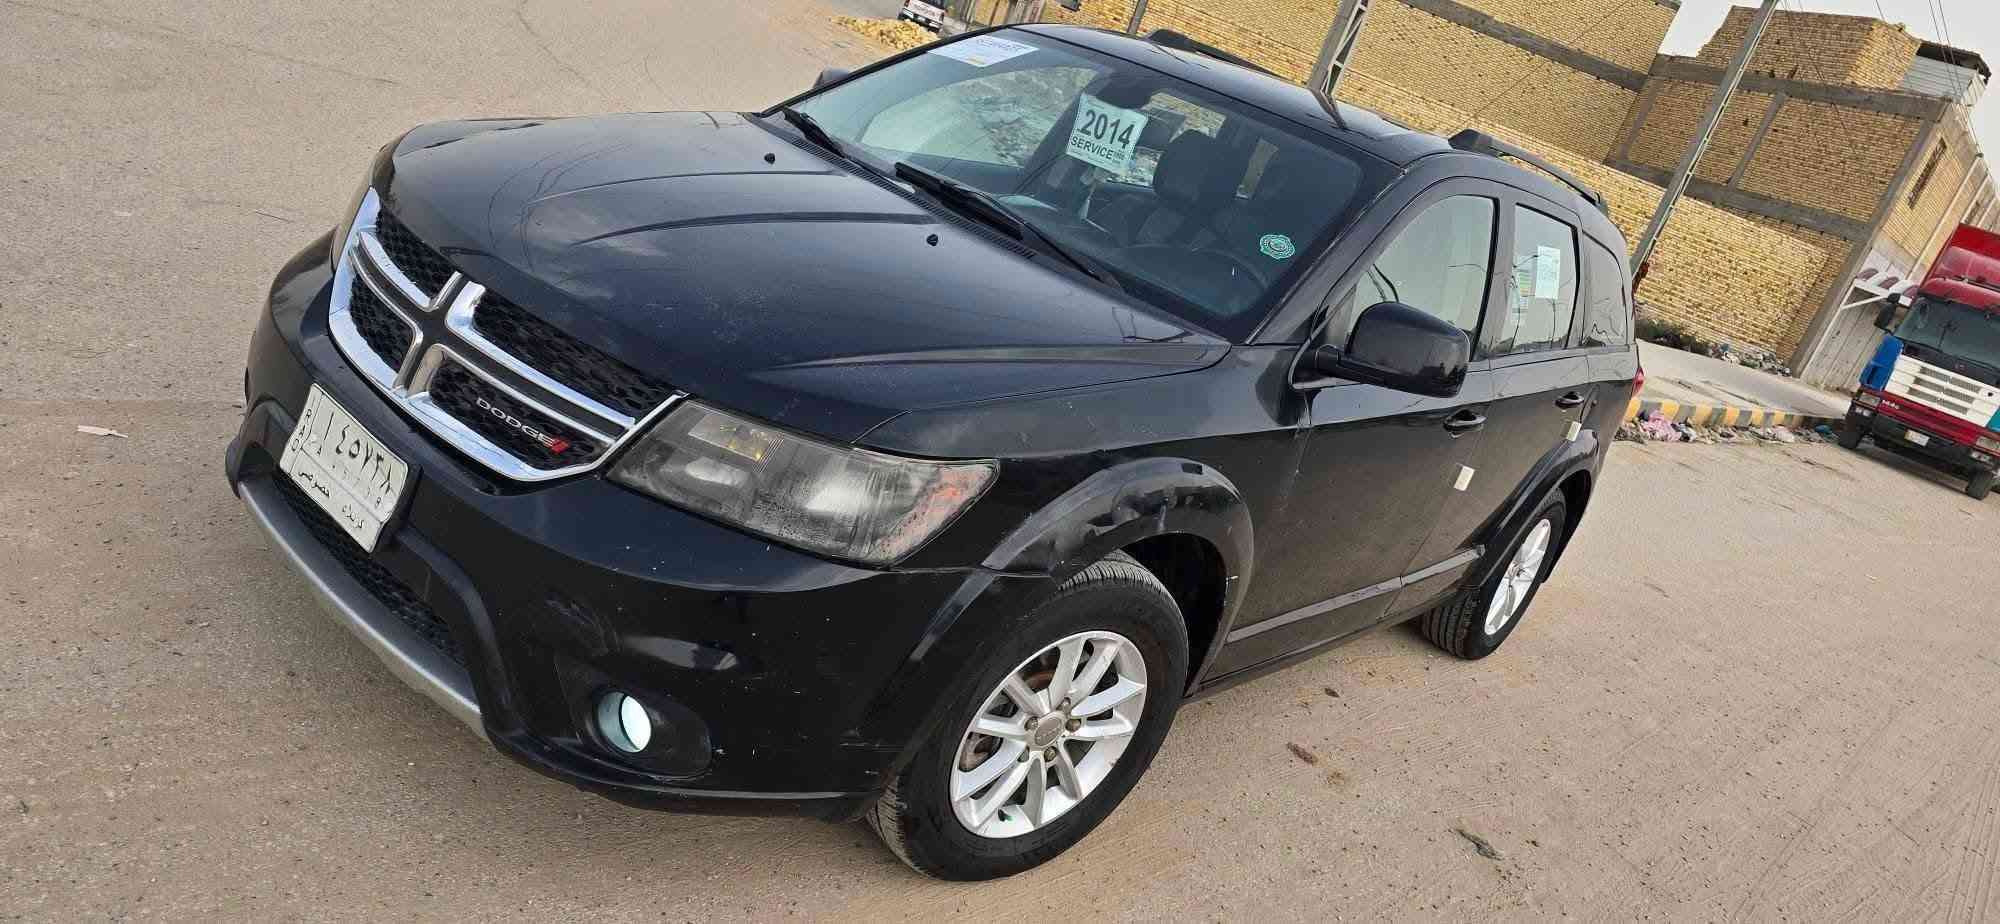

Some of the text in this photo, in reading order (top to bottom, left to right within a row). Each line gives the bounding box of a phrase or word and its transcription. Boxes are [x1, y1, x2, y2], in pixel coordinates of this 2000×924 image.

[1071, 136, 1114, 160] SERVICE
[1078, 109, 1135, 149] 2014
[476, 397, 555, 448] DODGE
